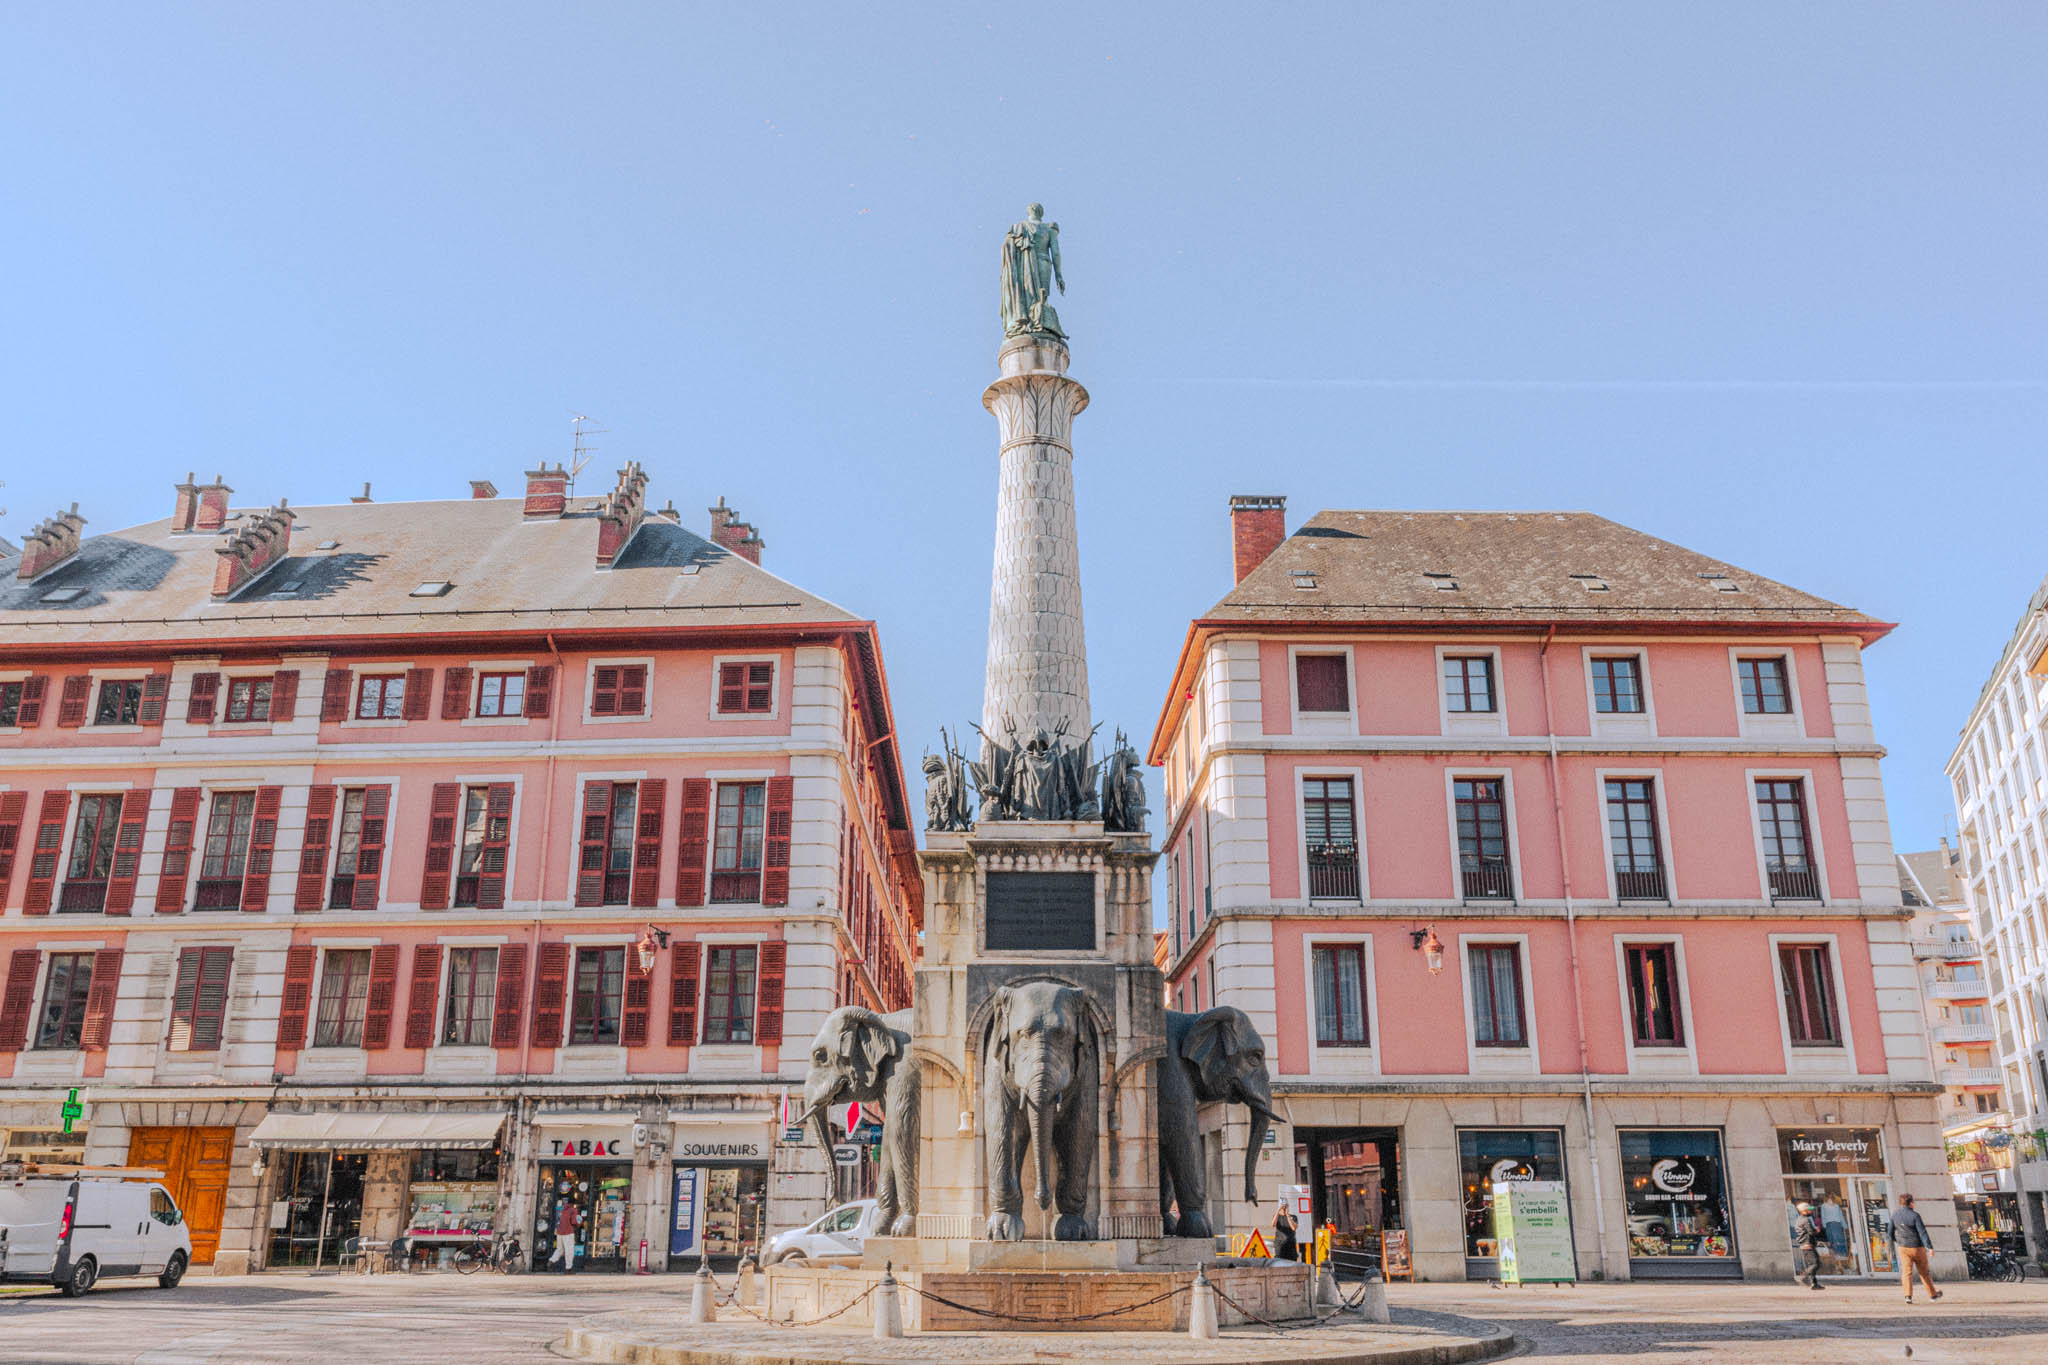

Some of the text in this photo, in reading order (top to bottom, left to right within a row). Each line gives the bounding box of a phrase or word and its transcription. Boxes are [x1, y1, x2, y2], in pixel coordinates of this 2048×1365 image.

[551, 1139, 620, 1156] TABAC
[684, 1143, 758, 1156] SOUVENIRS
[1792, 1139, 1868, 1154] Mary Beverly
[1520, 1206, 1559, 1214] s'embellit
